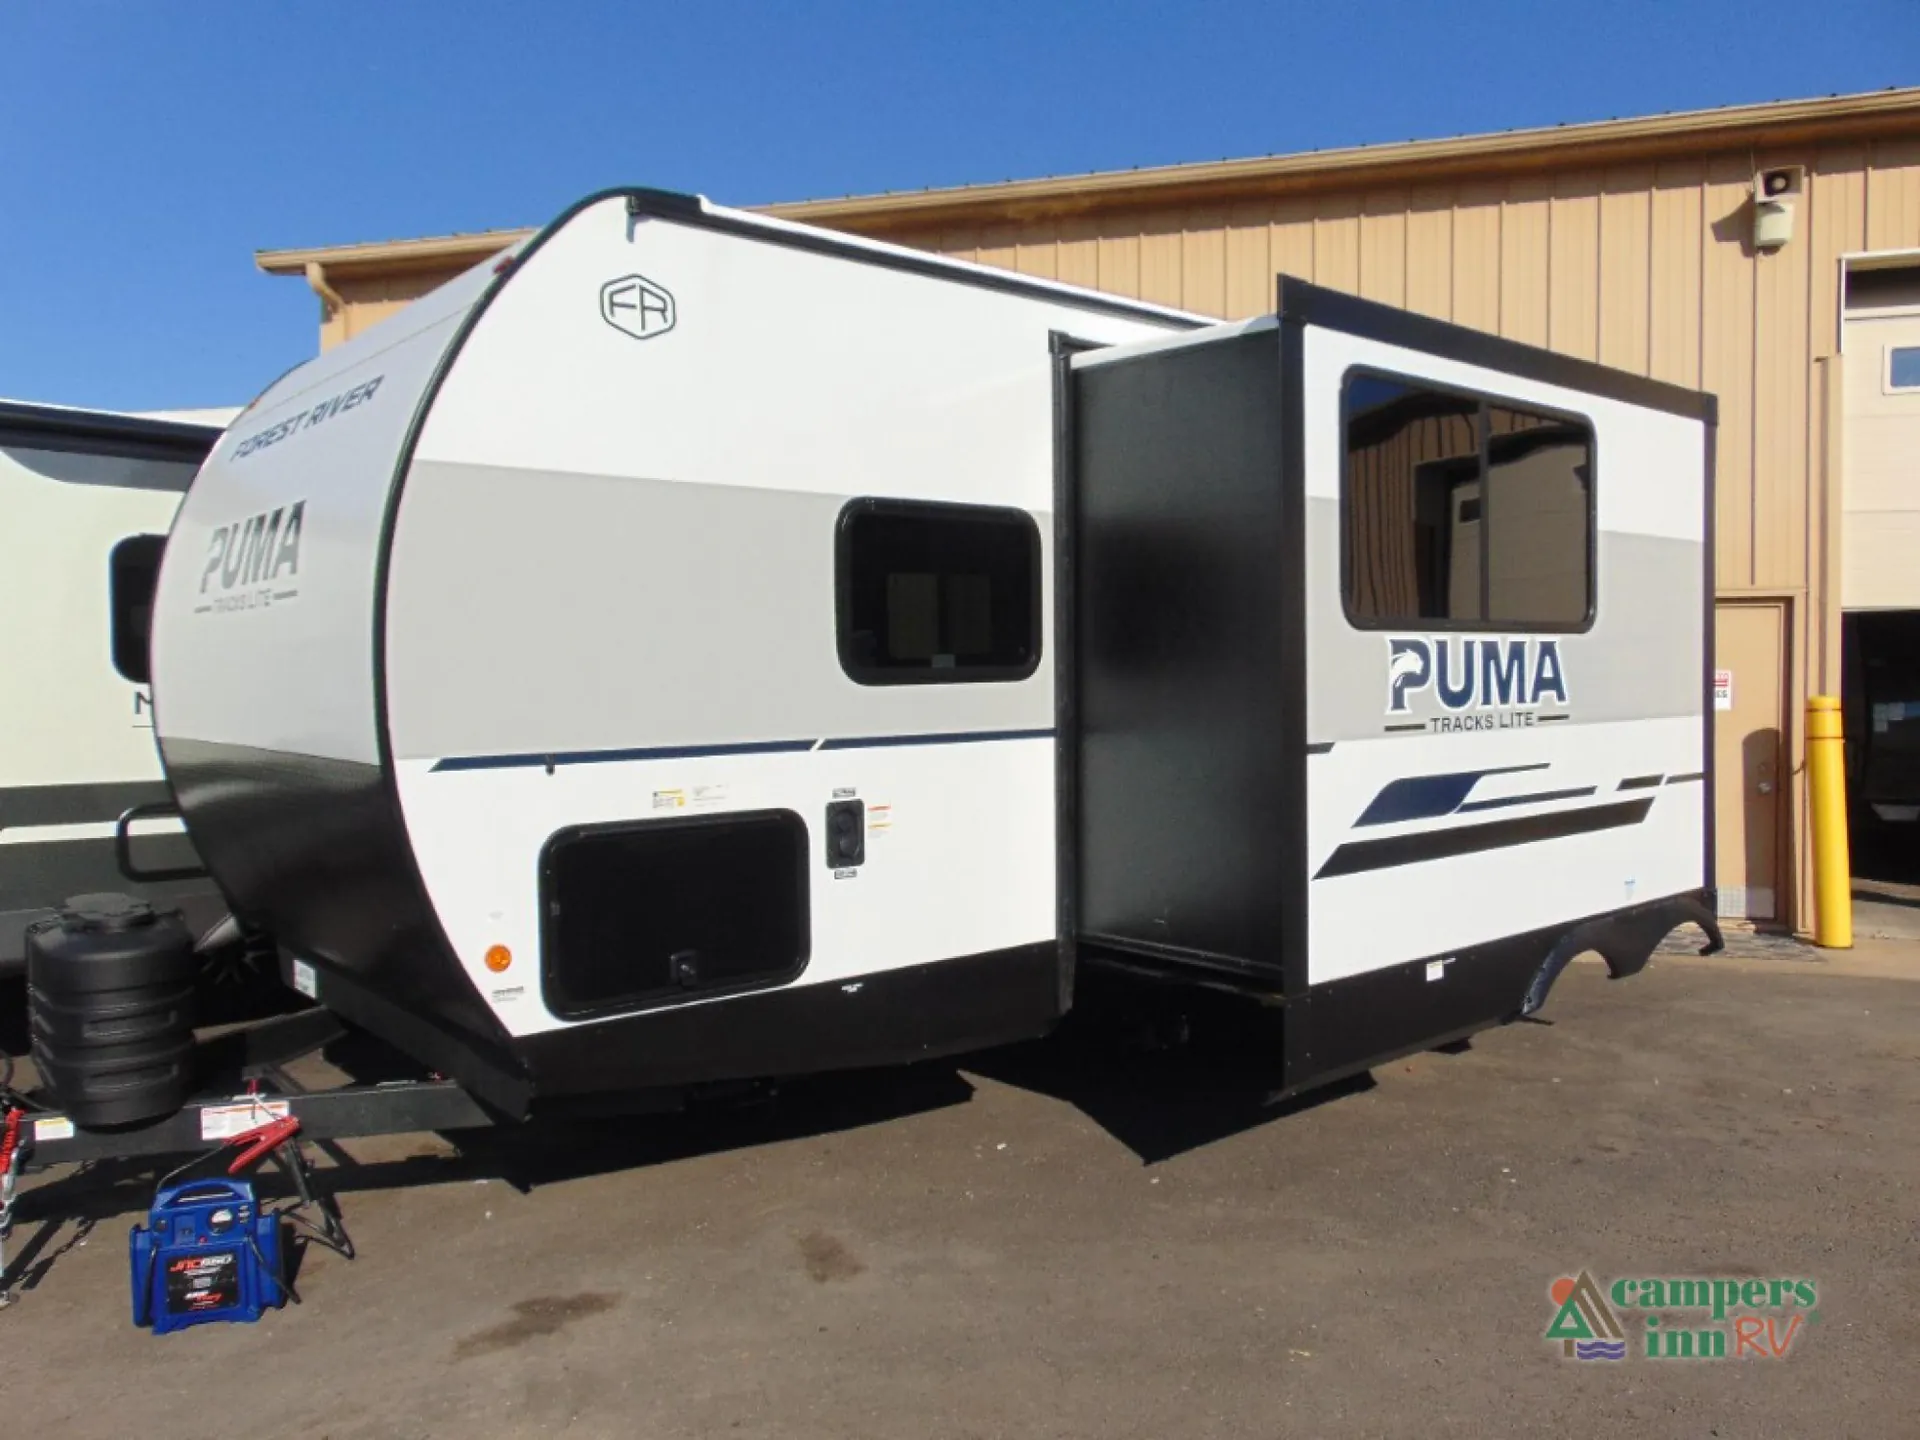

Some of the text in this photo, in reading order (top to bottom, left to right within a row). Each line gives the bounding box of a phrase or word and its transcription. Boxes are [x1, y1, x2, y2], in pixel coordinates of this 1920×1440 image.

[229, 374, 386, 462] FOREST RIVER
[201, 499, 307, 594] PUMA
[1386, 636, 1569, 713] PUMA
[1430, 711, 1534, 733] TRACKS LITE
